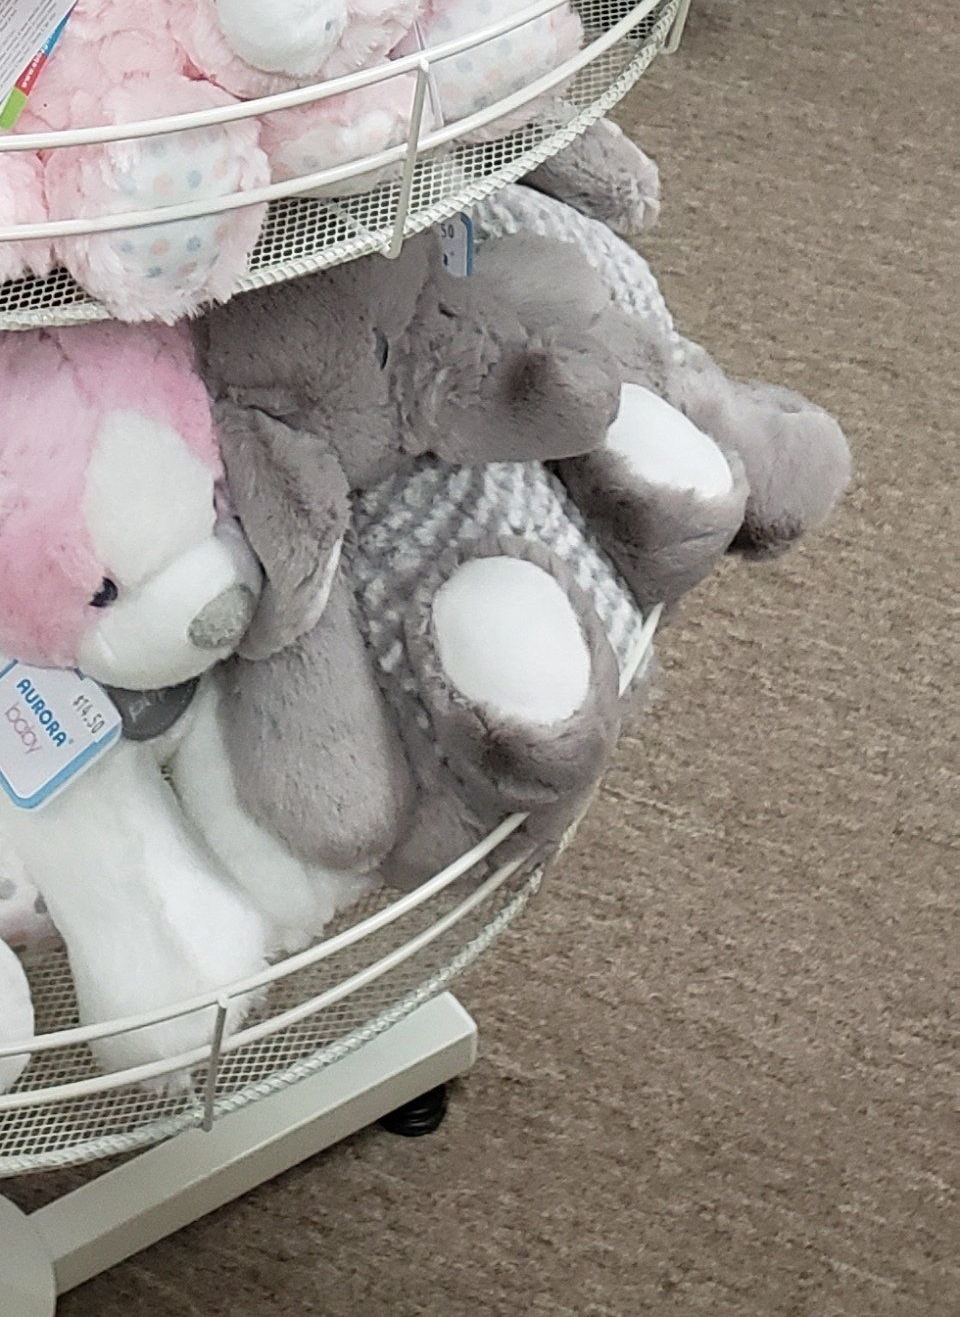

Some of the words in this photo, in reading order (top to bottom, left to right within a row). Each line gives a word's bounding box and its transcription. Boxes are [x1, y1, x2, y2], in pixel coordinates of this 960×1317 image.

[5, 701, 42, 755] baby
[16, 678, 68, 747] AURORA
[72, 694, 106, 734] $14.50
